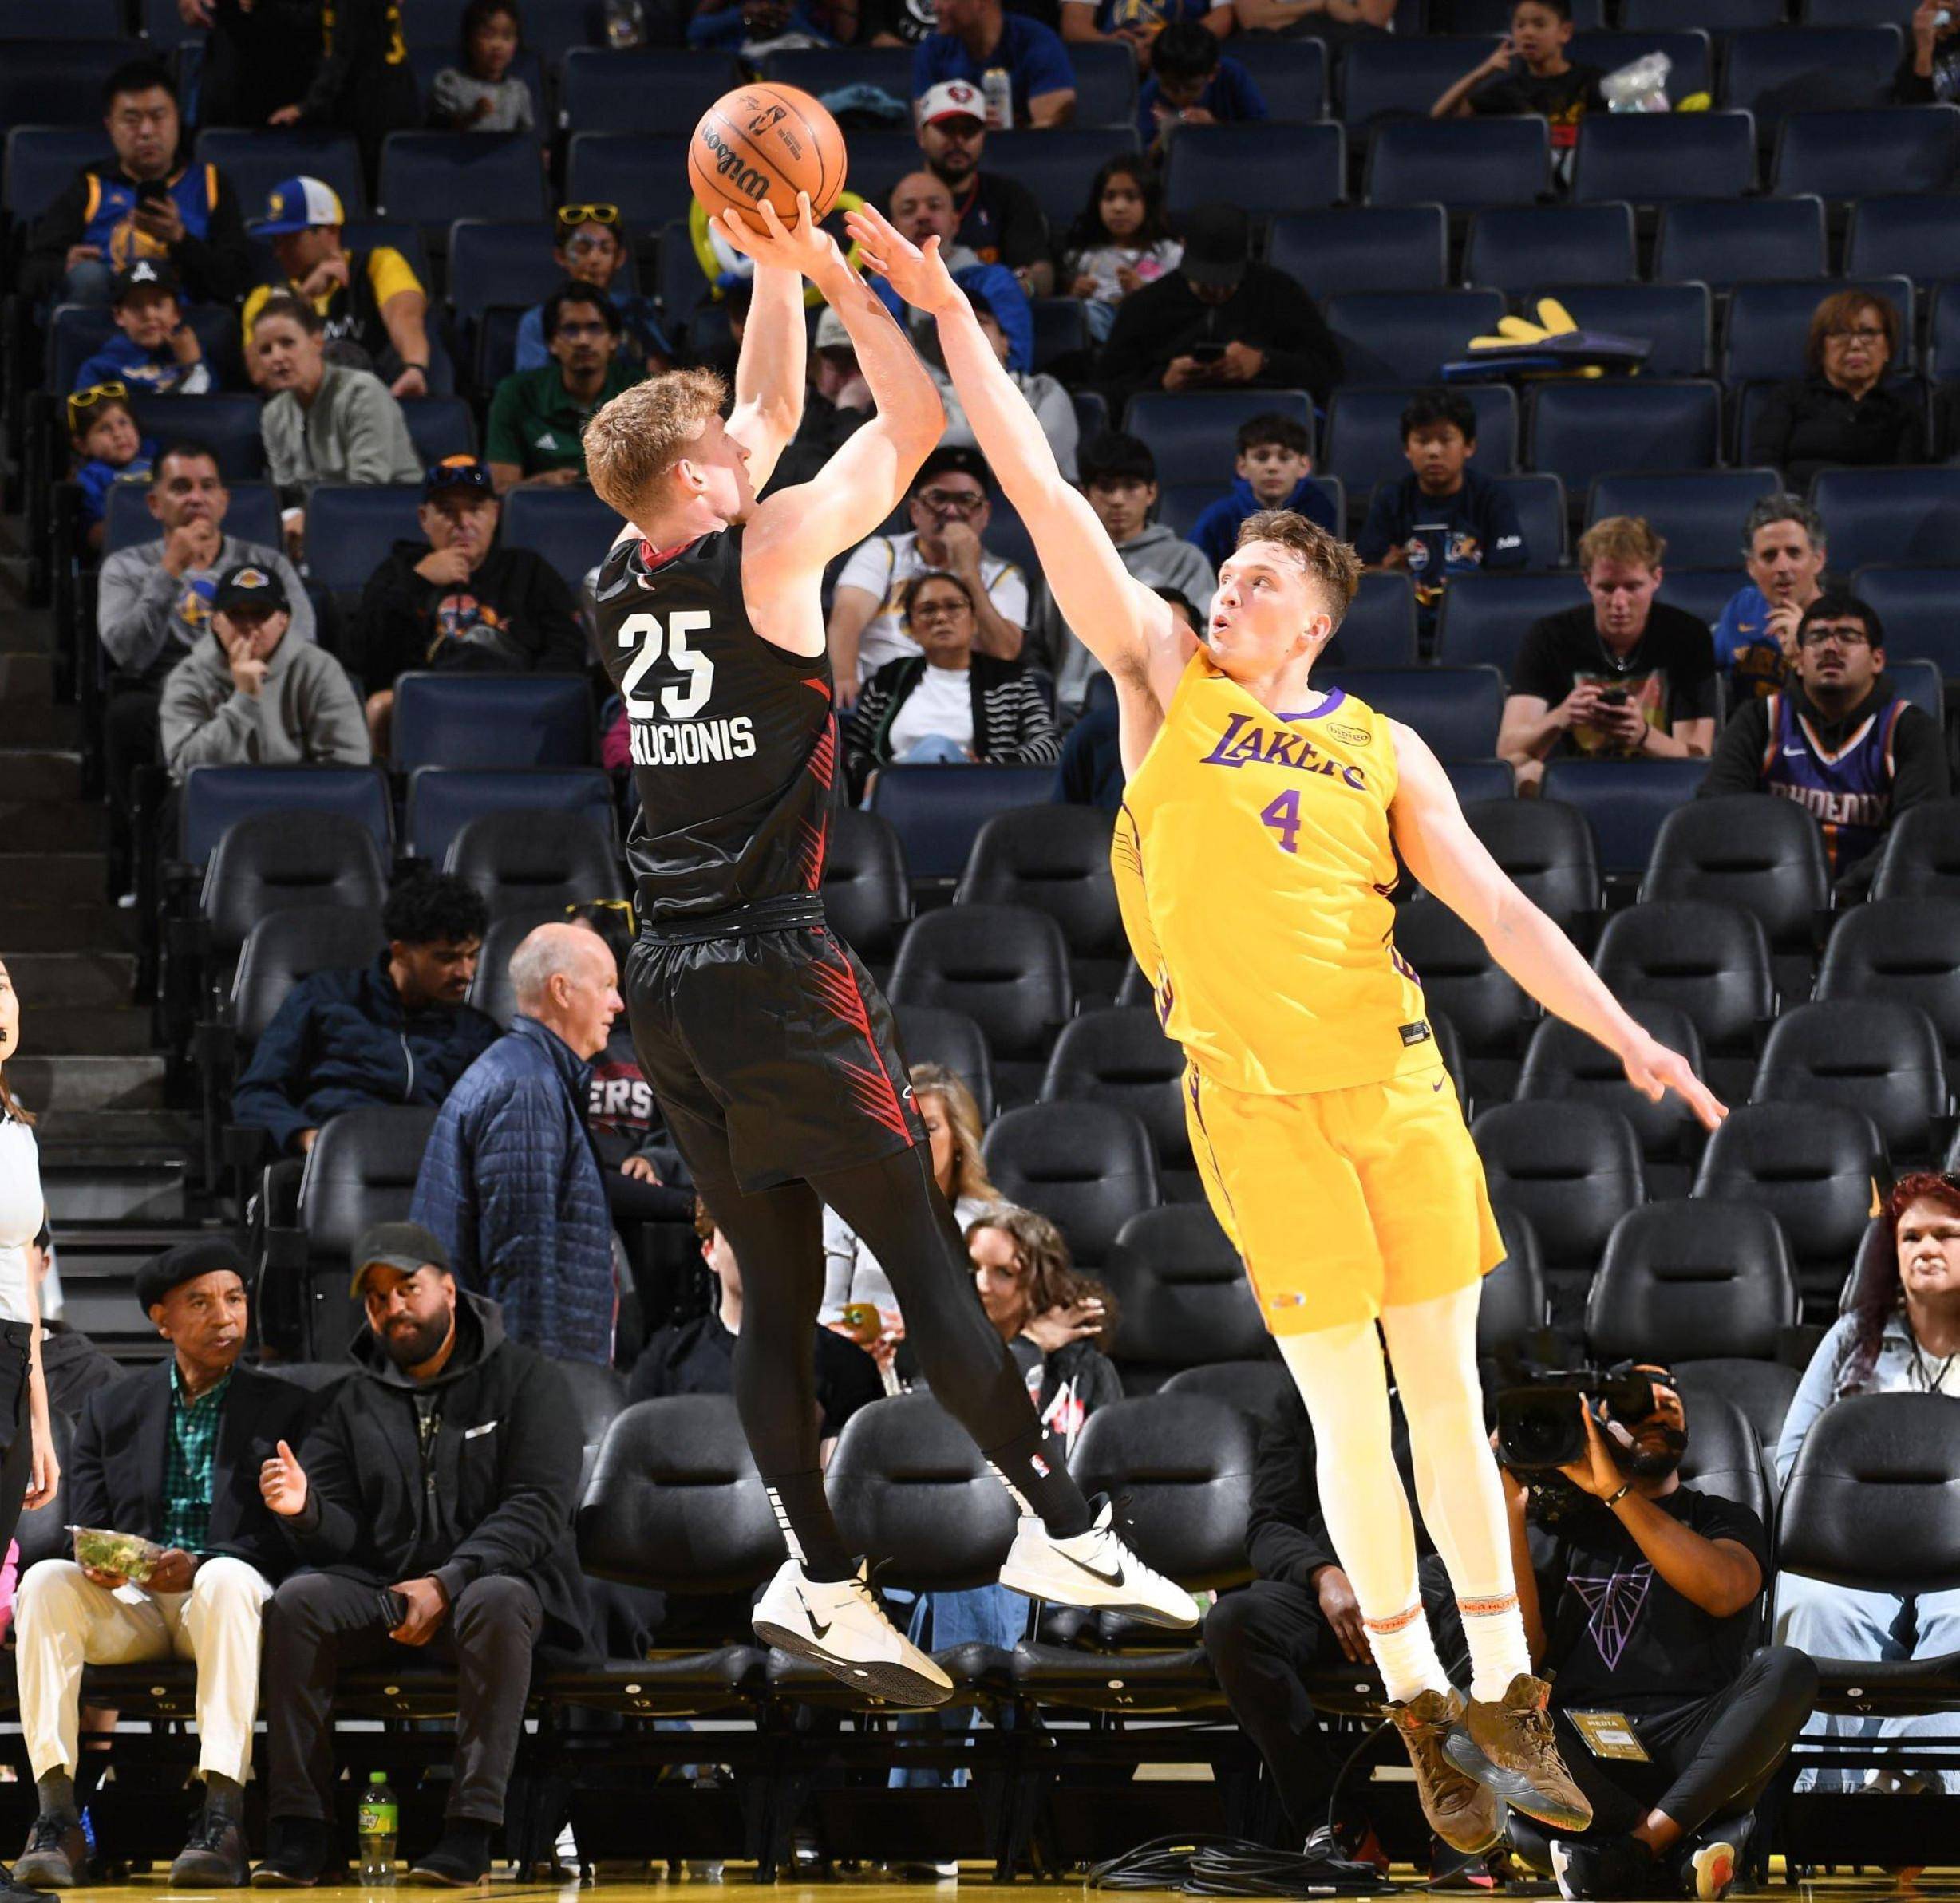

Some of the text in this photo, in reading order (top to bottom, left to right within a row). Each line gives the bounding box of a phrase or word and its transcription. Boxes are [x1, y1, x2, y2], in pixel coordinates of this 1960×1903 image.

[701, 122, 769, 200] Wilson
[618, 610, 714, 718] 25
[1260, 789, 1302, 854] 4
